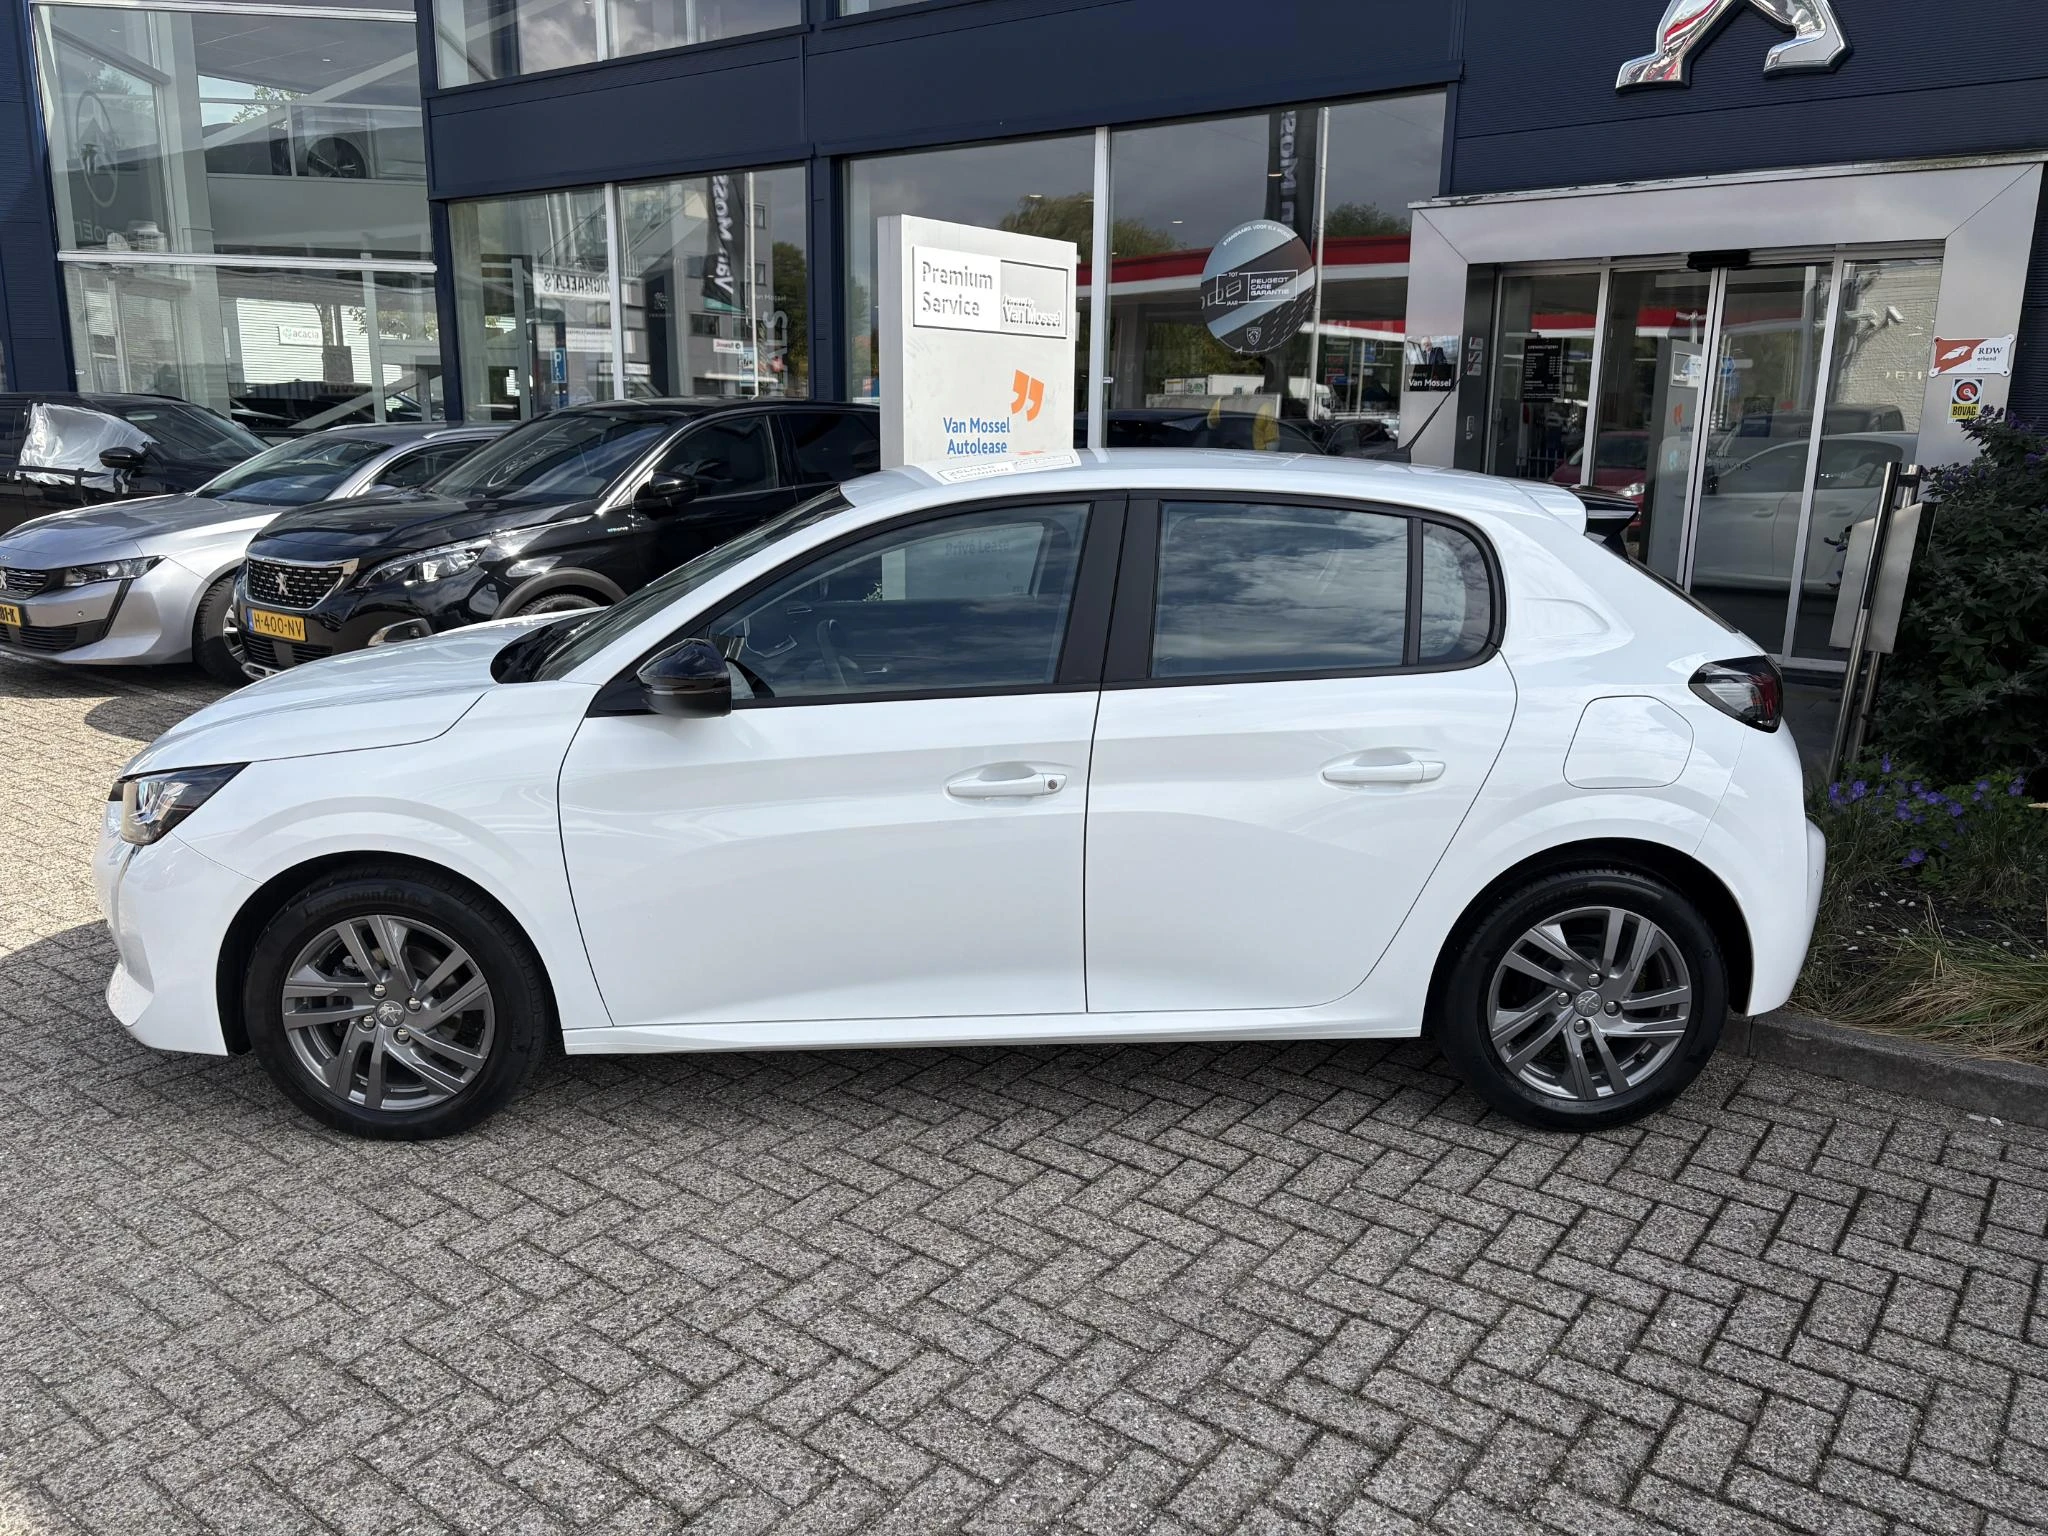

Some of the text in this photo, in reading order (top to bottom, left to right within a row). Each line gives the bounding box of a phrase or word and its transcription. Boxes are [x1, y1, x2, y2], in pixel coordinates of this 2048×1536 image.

[922, 261, 993, 290] Premium
[923, 291, 980, 317] Service
[1002, 306, 1062, 327] Van Mossel
[293, 330, 319, 339] acacia
[1978, 347, 2003, 355] RDW
[1408, 379, 1451, 387] Van Mossel
[1952, 406, 1976, 416] BOVAG
[943, 416, 1011, 434] Van Mossel
[947, 439, 1008, 455] Autolease
[254, 612, 302, 638] H-400-NV
